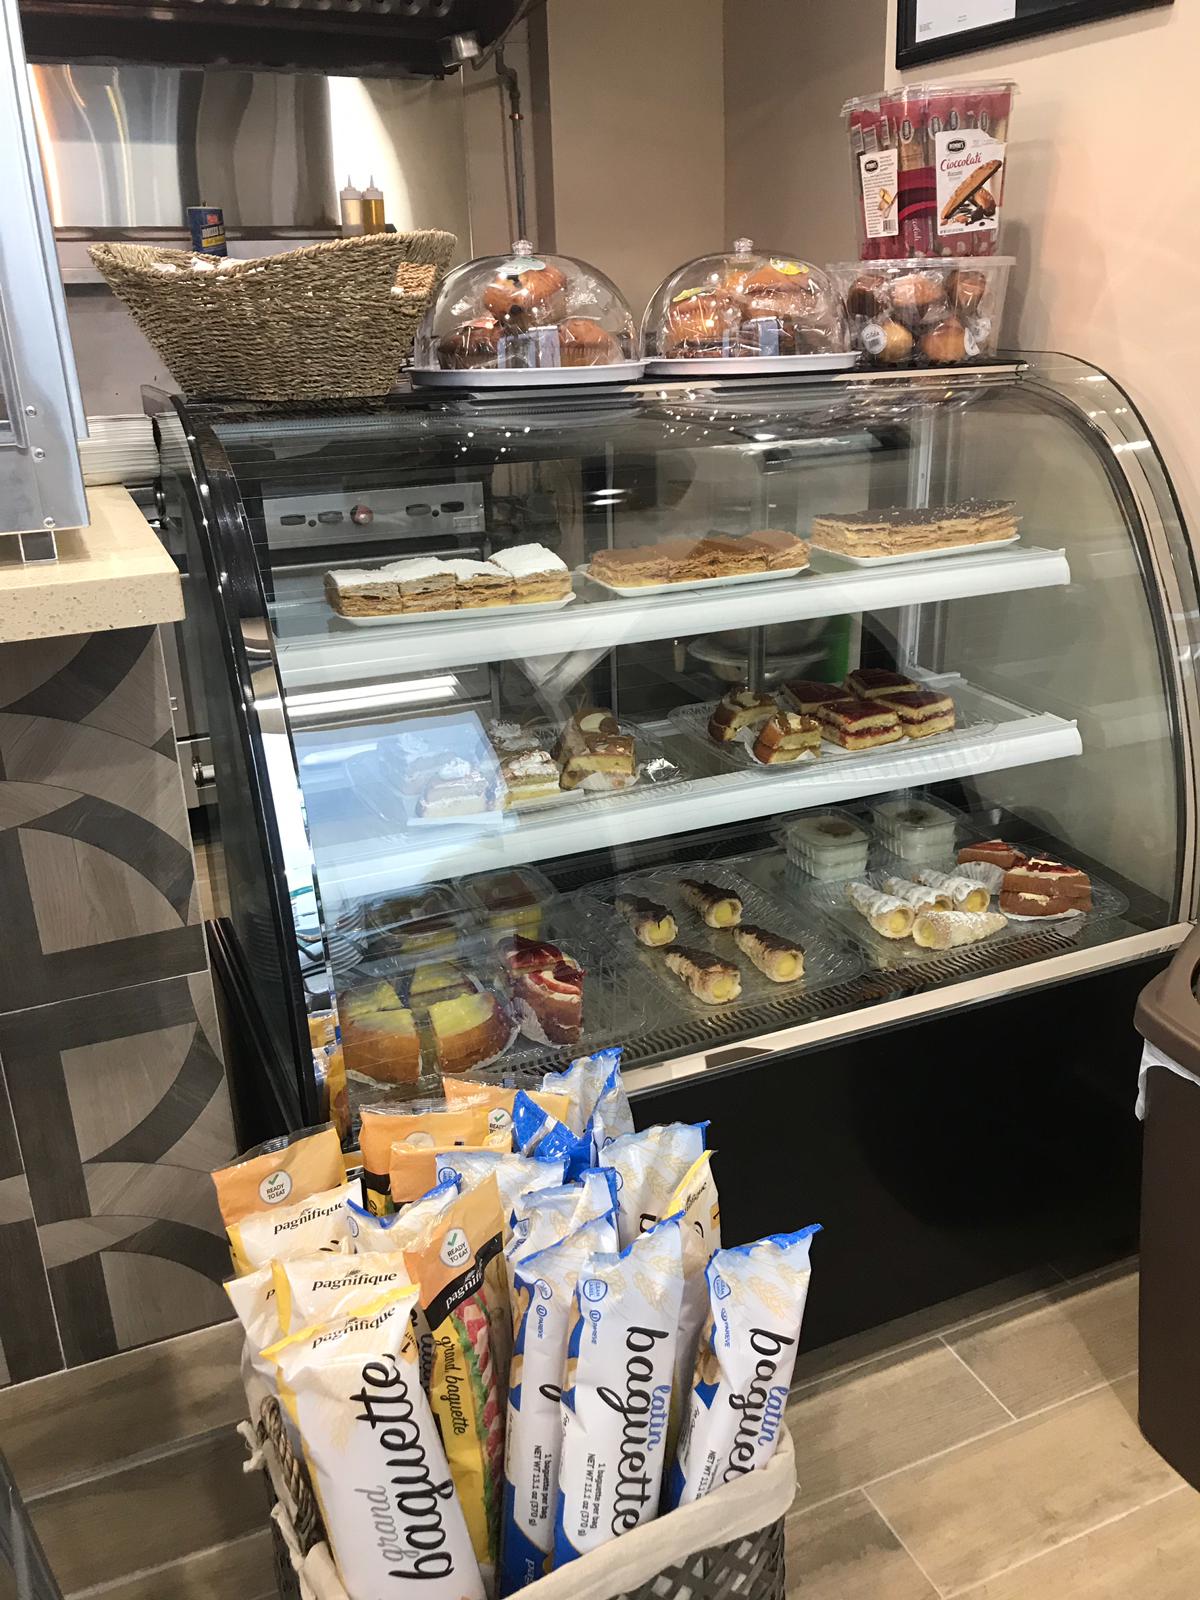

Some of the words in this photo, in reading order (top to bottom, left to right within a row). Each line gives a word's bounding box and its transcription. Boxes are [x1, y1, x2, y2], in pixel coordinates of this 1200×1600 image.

[940, 152, 982, 171] Cioccolati
[266, 1184, 285, 1195] READY
[276, 1189, 285, 1197] EAT
[447, 1242, 467, 1257] READY
[450, 1254, 459, 1263] TO
[459, 1249, 469, 1259] EAT
[311, 1272, 397, 1291] pagnifique
[312, 1307, 396, 1350] pagnifique
[435, 1336, 462, 1372] grand
[440, 1375, 469, 1436] baguette
[647, 1385, 672, 1451] latin
[757, 1386, 791, 1447] latin
[597, 1326, 669, 1537] baguette
[534, 1445, 542, 1460] NET
[706, 1450, 716, 1464] NET
[349, 1353, 455, 1580] baguette
[532, 1460, 541, 1473] WT
[587, 1453, 596, 1468] NET
[585, 1469, 595, 1481] WT
[540, 1505, 548, 1519] bag
[354, 1485, 420, 1562] grand
[590, 1515, 599, 1529] bag
